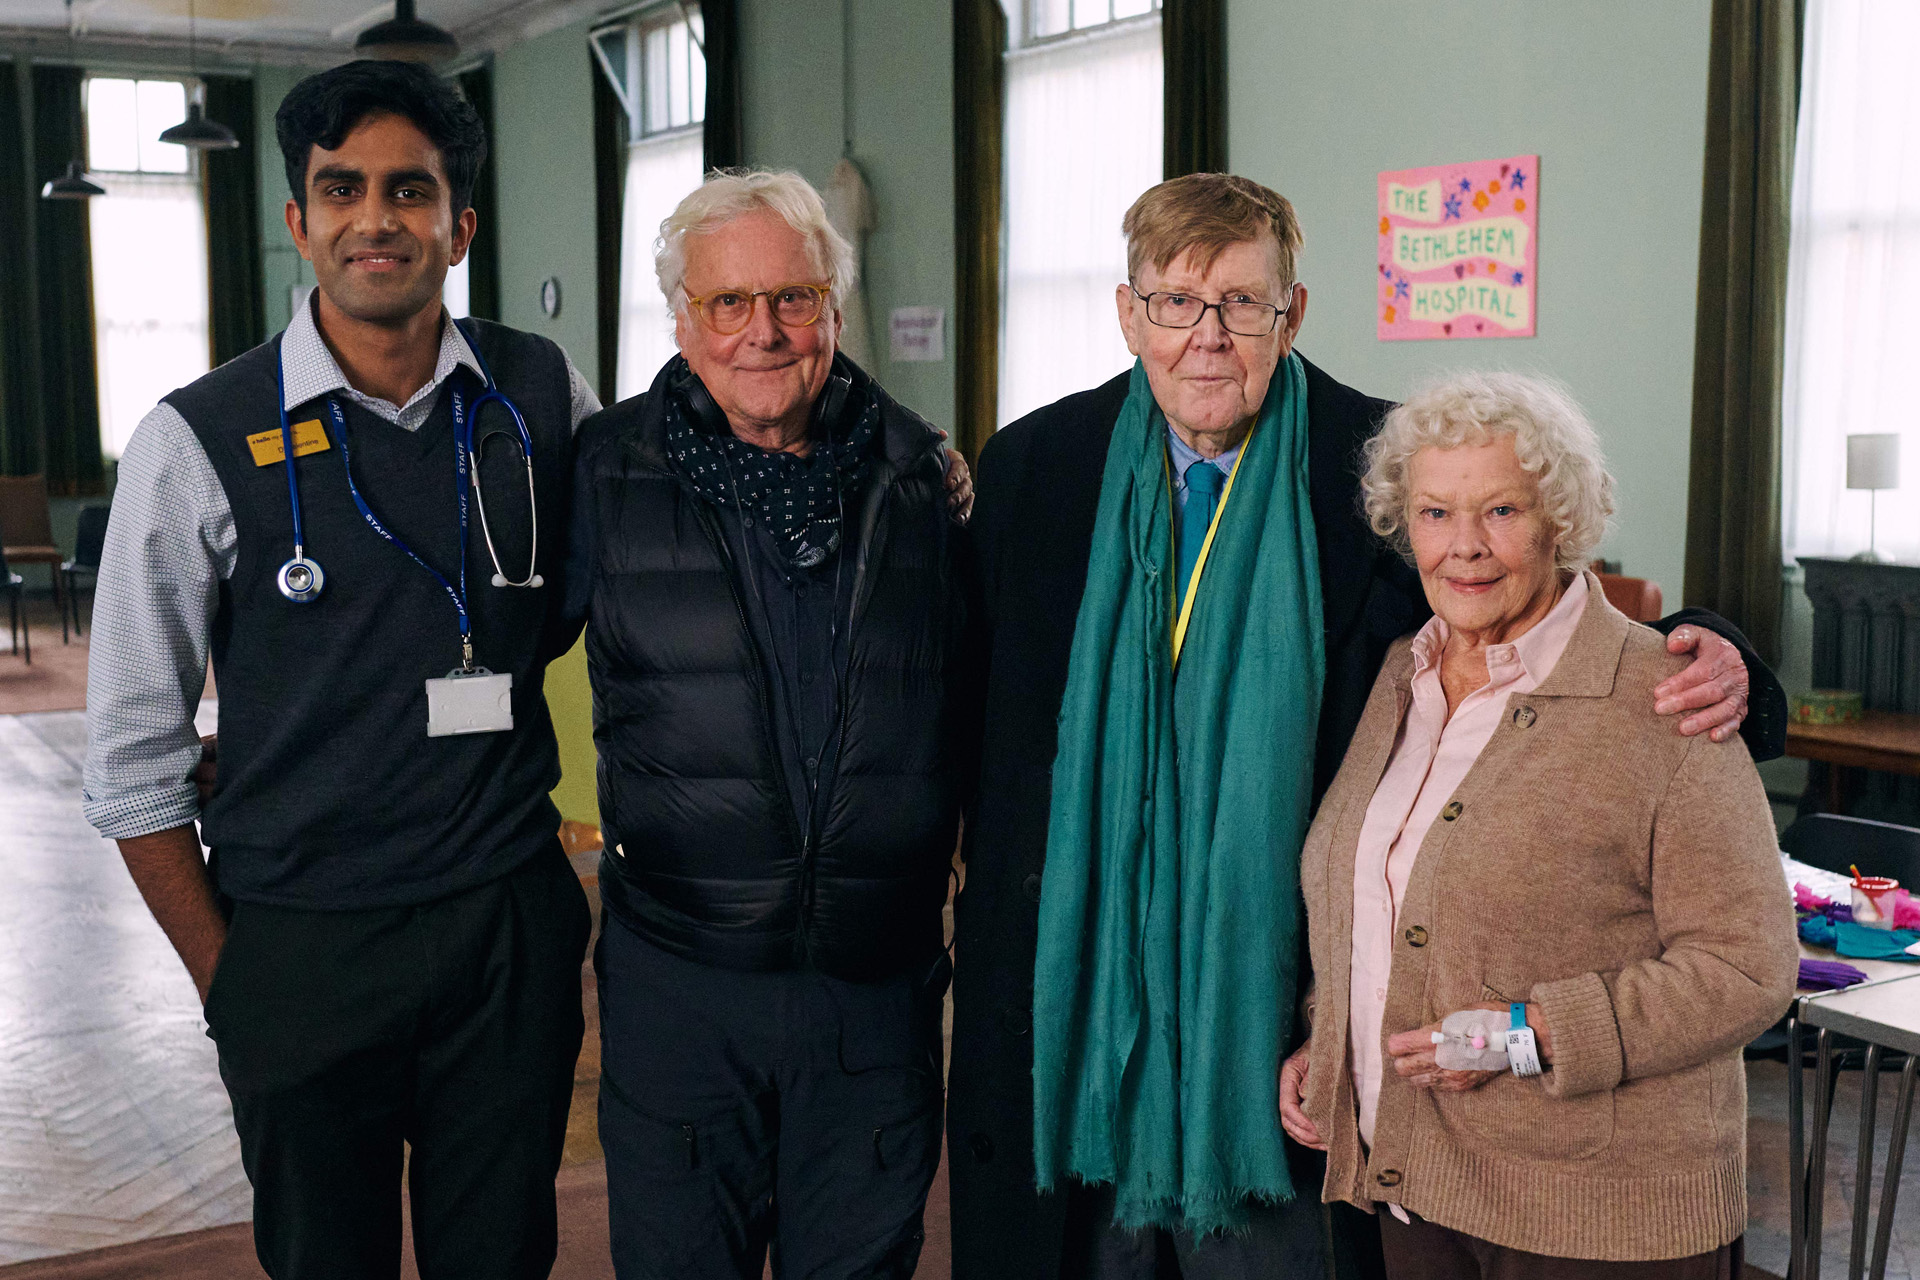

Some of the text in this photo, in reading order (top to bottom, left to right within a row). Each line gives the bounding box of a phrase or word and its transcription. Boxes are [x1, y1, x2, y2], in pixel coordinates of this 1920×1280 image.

[1394, 190, 1428, 212] THE
[1400, 228, 1515, 262] BETHLEHEM
[1415, 286, 1517, 318] HOSPITAL
[331, 400, 344, 424] AFF
[453, 391, 464, 424] STAFF
[457, 441, 466, 474] STAFF
[365, 513, 393, 541] STAFF
[446, 586, 466, 616] STAFF
